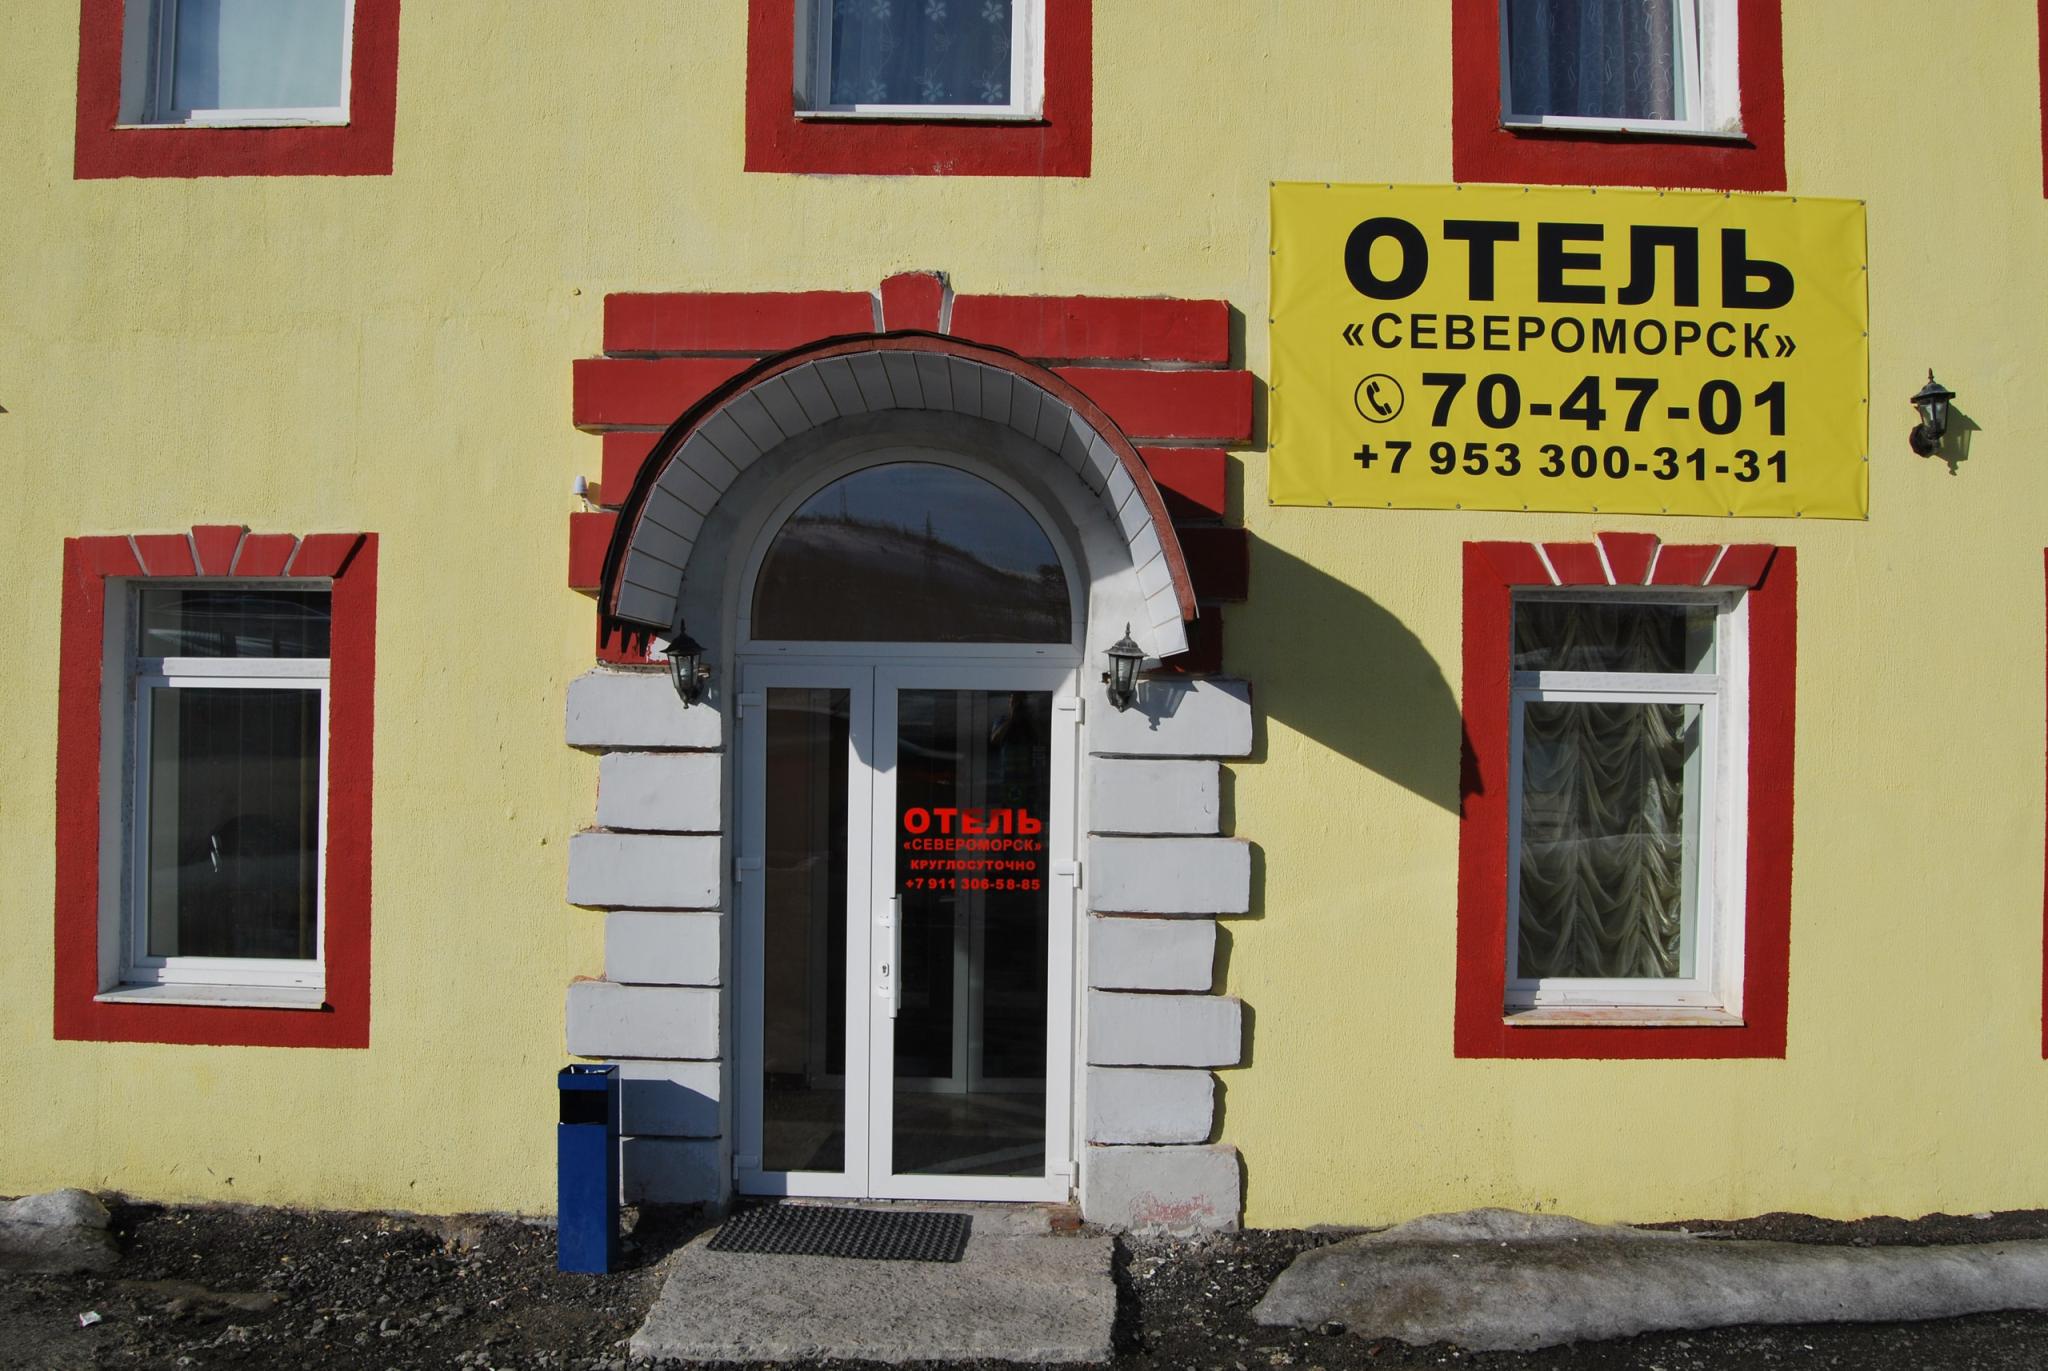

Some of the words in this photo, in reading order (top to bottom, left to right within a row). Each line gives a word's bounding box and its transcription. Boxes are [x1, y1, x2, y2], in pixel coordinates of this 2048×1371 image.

[1344, 217, 1795, 309] ОТЕЛЬ
[1342, 313, 1797, 359] «СЕВЕРОМОРСК»
[1422, 373, 1786, 436] 70-47-01
[1354, 441, 1412, 474] +7
[1430, 442, 1522, 476] 953
[1539, 445, 1787, 482] 300-31-31
[904, 807, 1042, 834] ОТЕЛЬ
[904, 838, 1042, 852] «СЕВЕРОМОРСК»
[910, 859, 1037, 871] КРУГЛОСУТОЧНО
[905, 878, 924, 889] +7
[928, 878, 956, 890] 911
[961, 878, 1041, 891] 306-58-85
